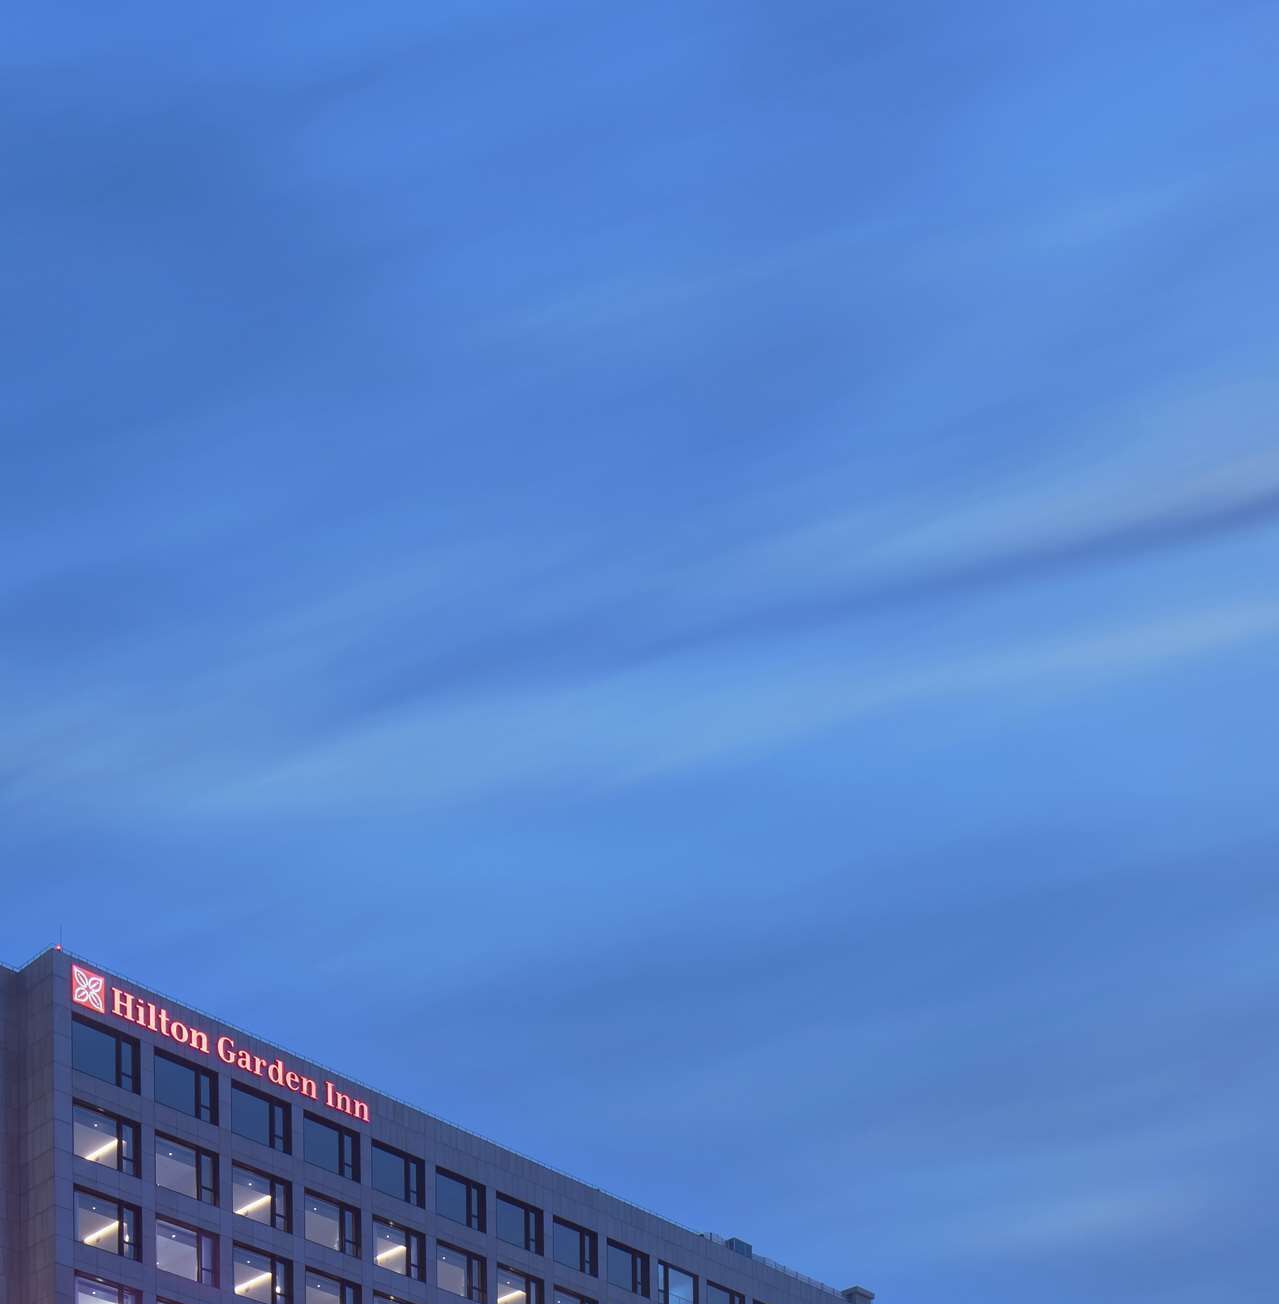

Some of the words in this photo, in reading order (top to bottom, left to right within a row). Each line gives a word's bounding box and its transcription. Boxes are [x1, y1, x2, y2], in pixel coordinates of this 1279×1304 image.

[111, 987, 210, 1054] Hilton
[217, 1036, 318, 1100] Garden
[324, 1080, 370, 1123] Inn
